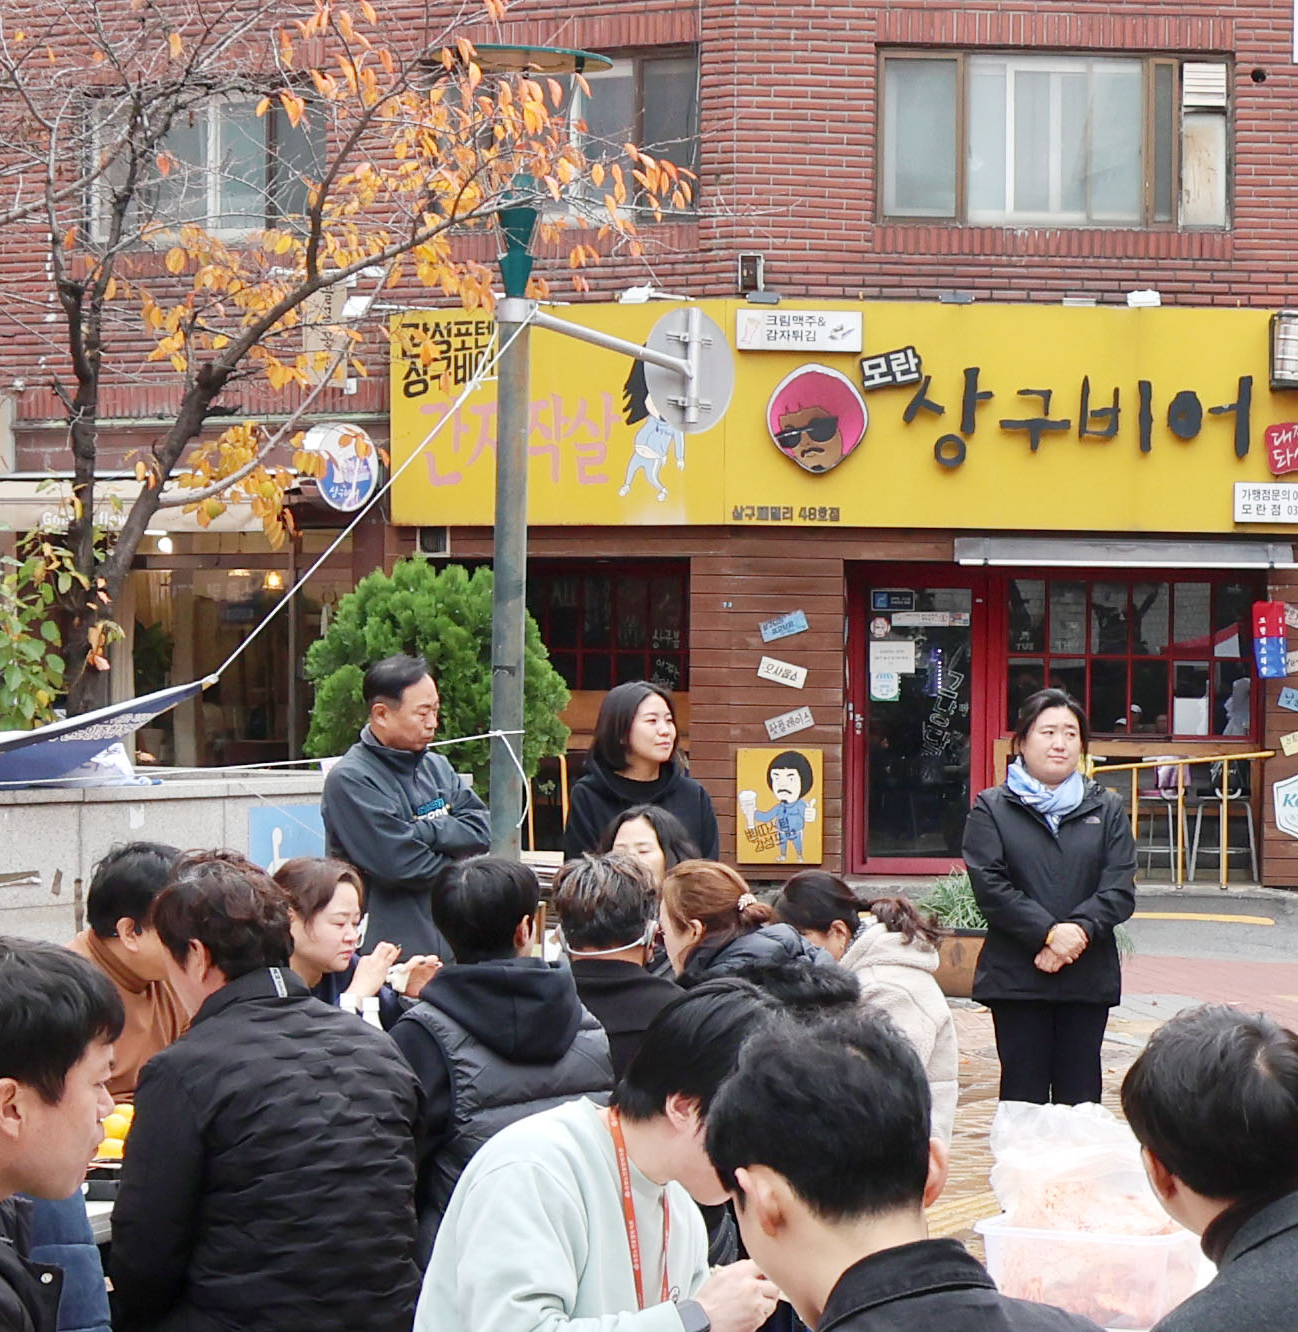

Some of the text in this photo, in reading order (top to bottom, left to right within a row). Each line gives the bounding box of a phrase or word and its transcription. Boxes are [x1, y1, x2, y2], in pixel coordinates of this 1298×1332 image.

[766, 314, 826, 327] 크림맥주&
[766, 329, 817, 342] 감자튀김
[862, 349, 919, 387] 모란
[902, 366, 1254, 468] 상구비어
[1242, 488, 1290, 501] 가맹점문의
[732, 506, 840, 522] 상구패밀리 48호점
